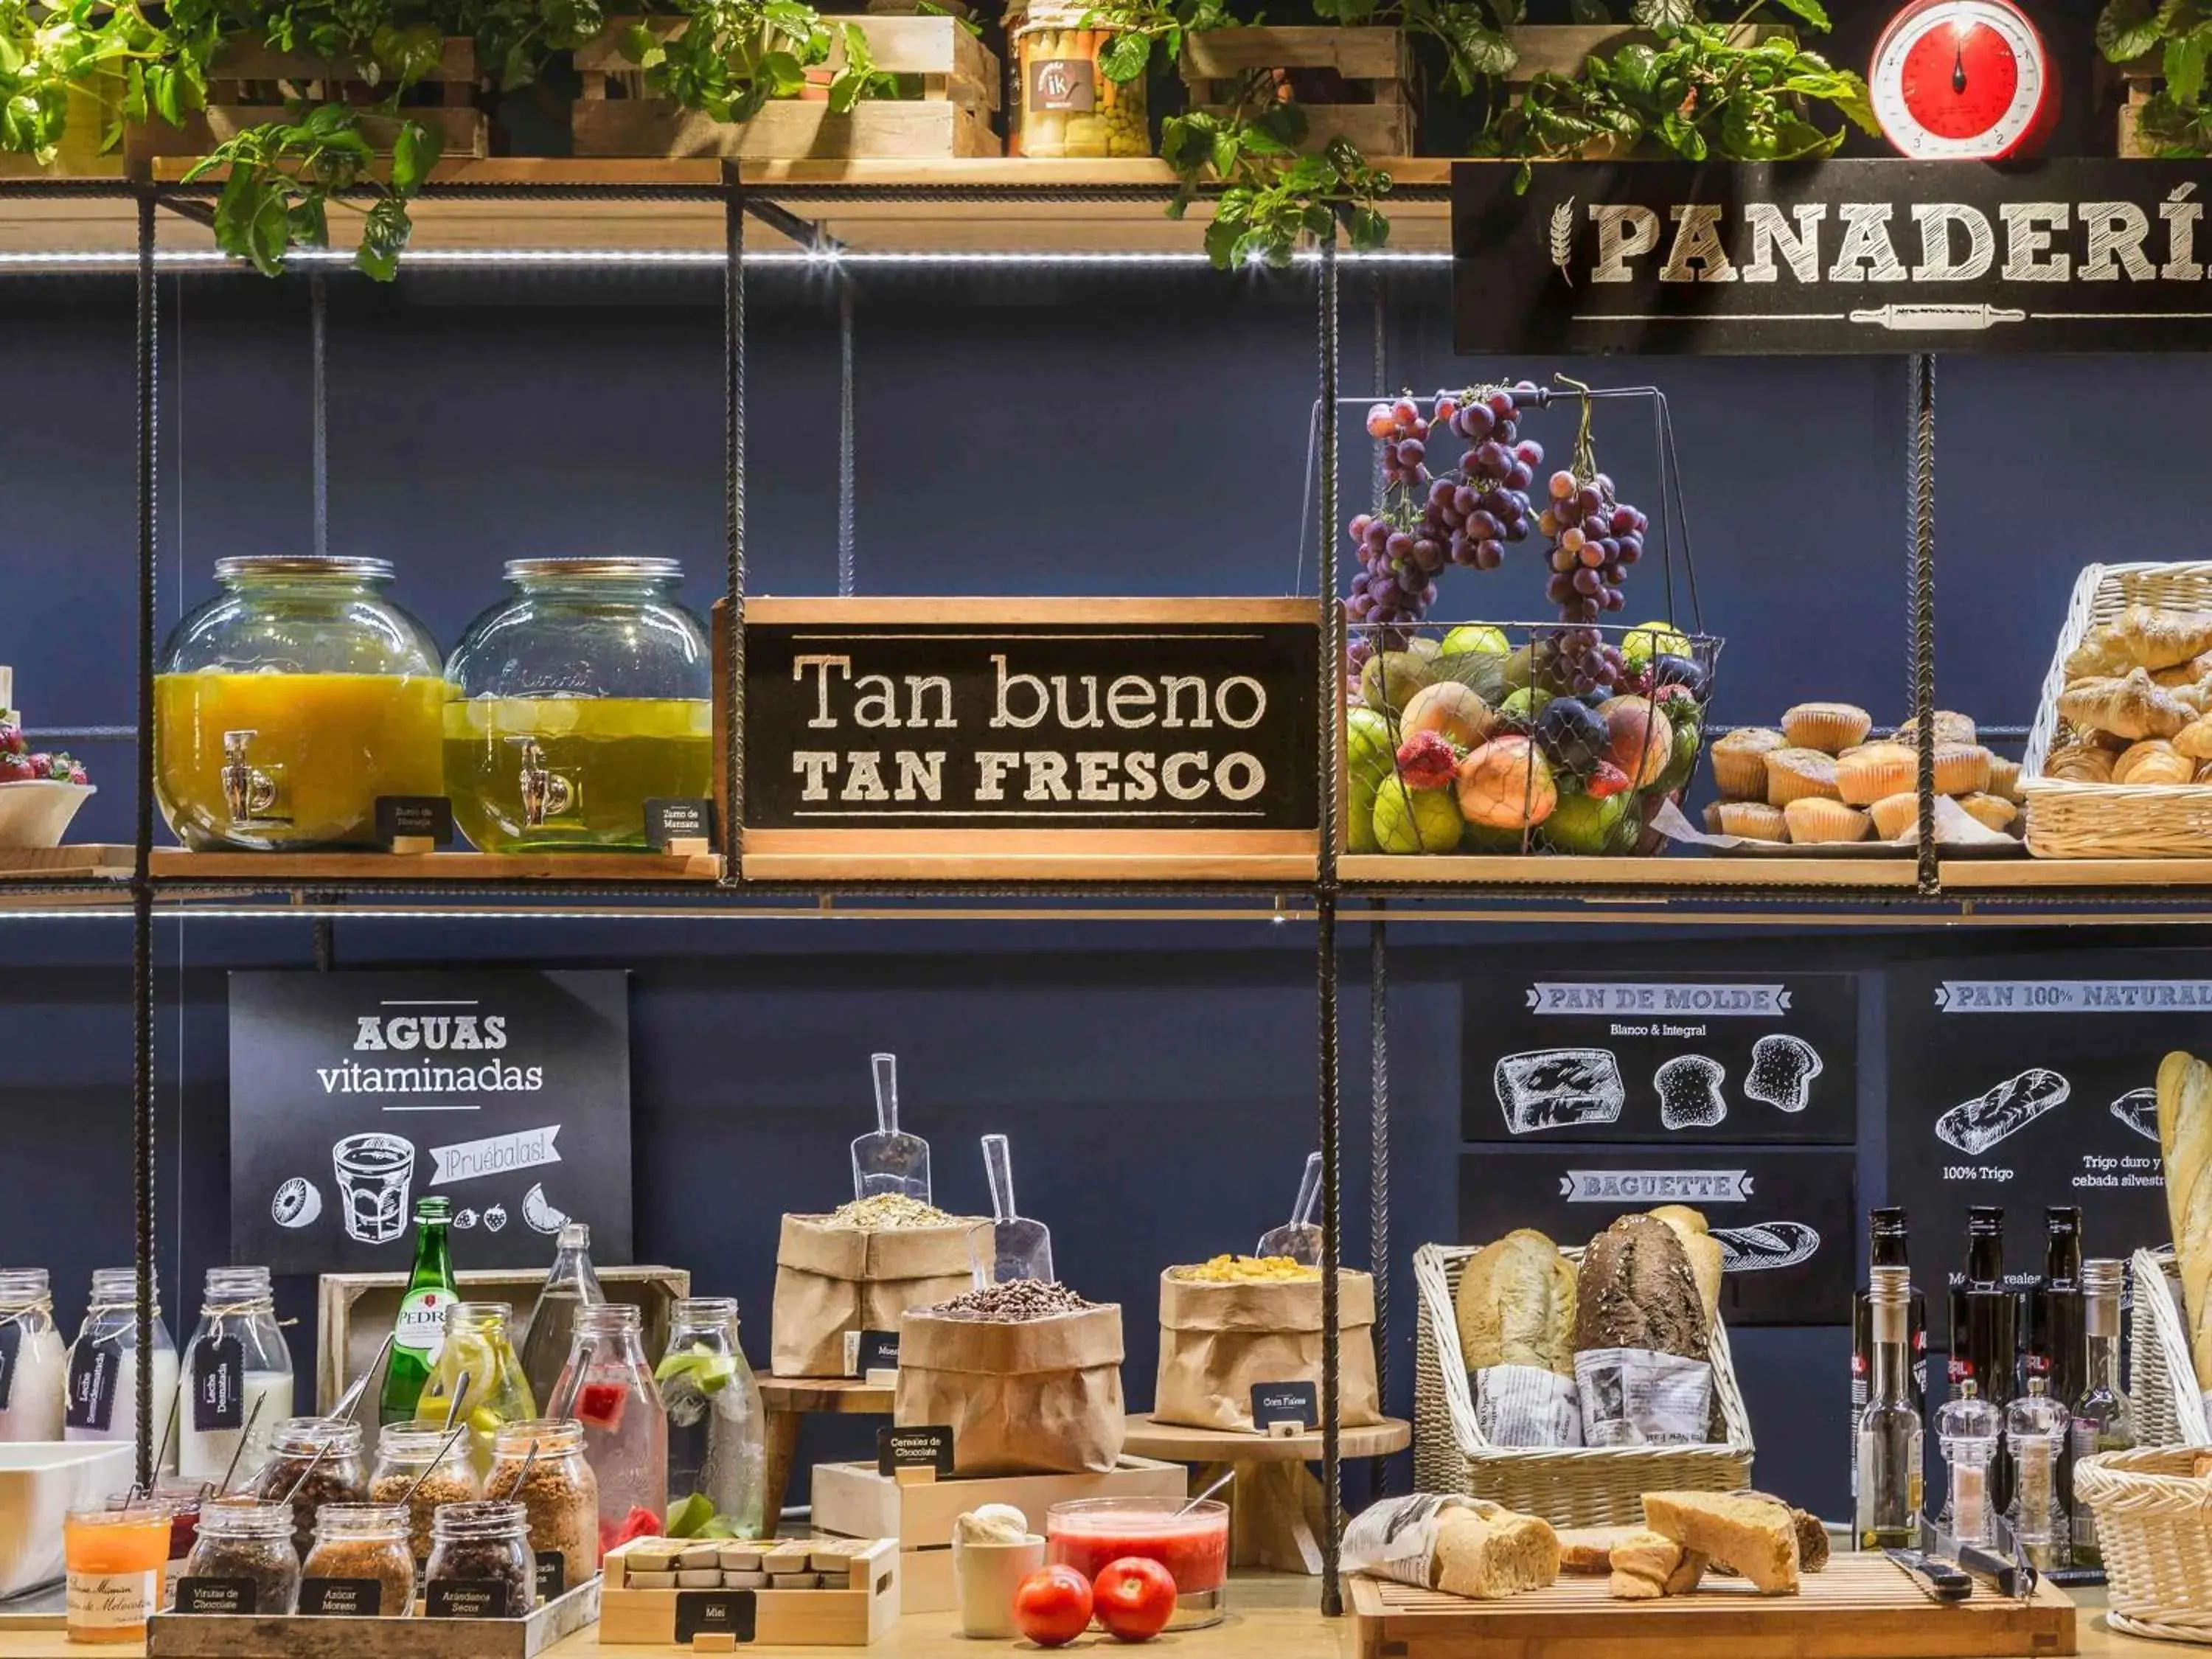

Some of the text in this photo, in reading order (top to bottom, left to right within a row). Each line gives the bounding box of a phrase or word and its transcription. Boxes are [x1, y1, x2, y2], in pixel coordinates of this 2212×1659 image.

[1589, 181, 2212, 282] PANADERÍ
[793, 654, 1267, 729] Tan bueno
[793, 751, 1267, 801] TAN FRESCO
[664, 809, 699, 818] Zumo de
[664, 819, 700, 829] Manzana
[1548, 987, 1770, 1011] PAN DE MOLDE
[1955, 986, 2014, 1007] PAN
[2024, 986, 2073, 1006] 100%
[353, 1016, 508, 1051] AGUAS
[1610, 1024, 1706, 1038] Blanco & Integral
[316, 1058, 543, 1093] vitaminadas
[444, 1133, 546, 1178] ¡Pruébalas!
[2083, 1155, 2160, 1169] Trigo duro y
[1943, 1167, 2014, 1182] 100% Trigo
[2072, 1174, 2166, 1187] cebada silvestr
[1583, 1176, 1731, 1196] BAGUETTE
[399, 1311, 447, 1325] PEDR
[79, 1371, 91, 1402] Leche
[206, 1374, 217, 1404] Leche
[217, 1363, 228, 1413] Desnatada
[1263, 1397, 1306, 1407] Corn Flakes
[891, 1437, 941, 1447] Cereales de
[895, 1447, 937, 1457] Chocolate
[226, 1589, 238, 1599] de
[324, 1589, 356, 1601] Azúcar
[322, 1601, 356, 1611] Moreno
[451, 1603, 479, 1613] Secos
[706, 1607, 726, 1617] Miel
